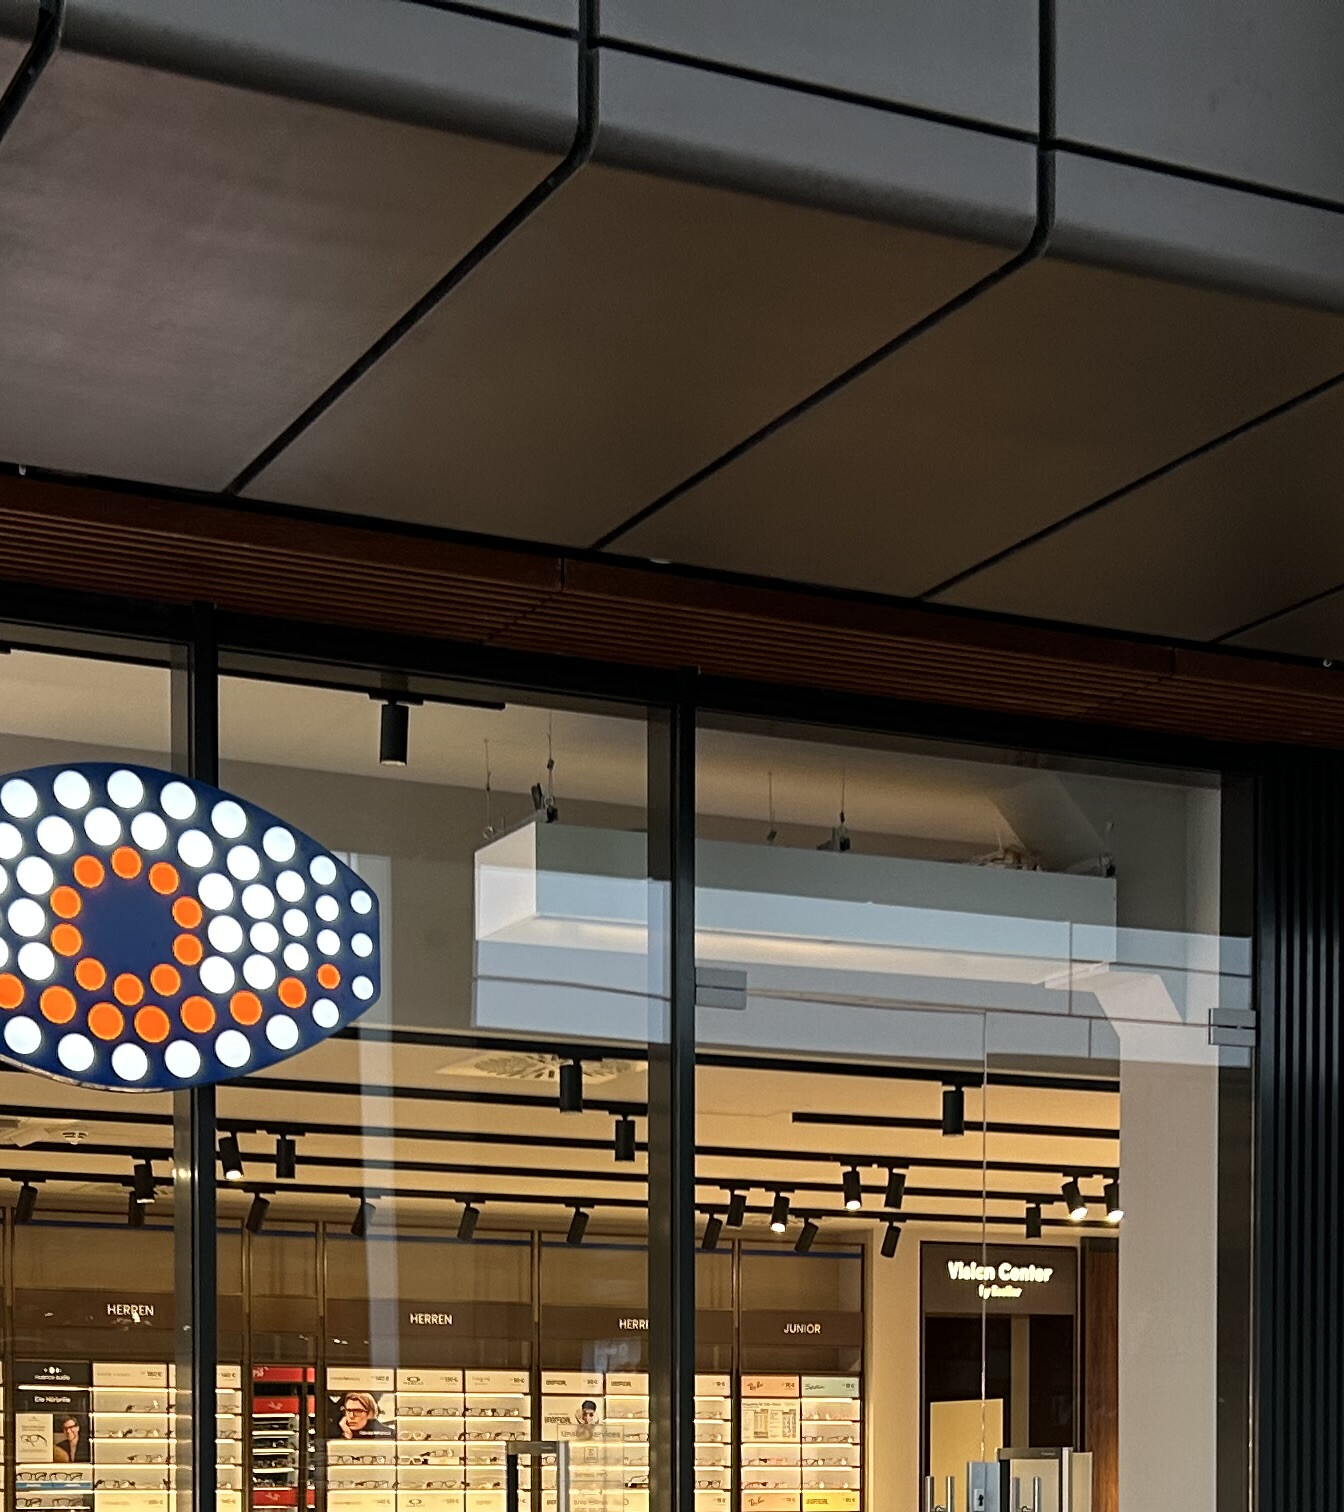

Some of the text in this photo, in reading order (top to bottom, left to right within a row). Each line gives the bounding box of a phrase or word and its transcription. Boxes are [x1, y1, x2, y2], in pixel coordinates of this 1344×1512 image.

[947, 1261, 1054, 1283] Vision Center
[107, 1303, 155, 1317] HERREN
[409, 1313, 453, 1326] HERREN
[618, 1318, 649, 1330] HERR
[783, 1323, 821, 1335] JUNIOR
